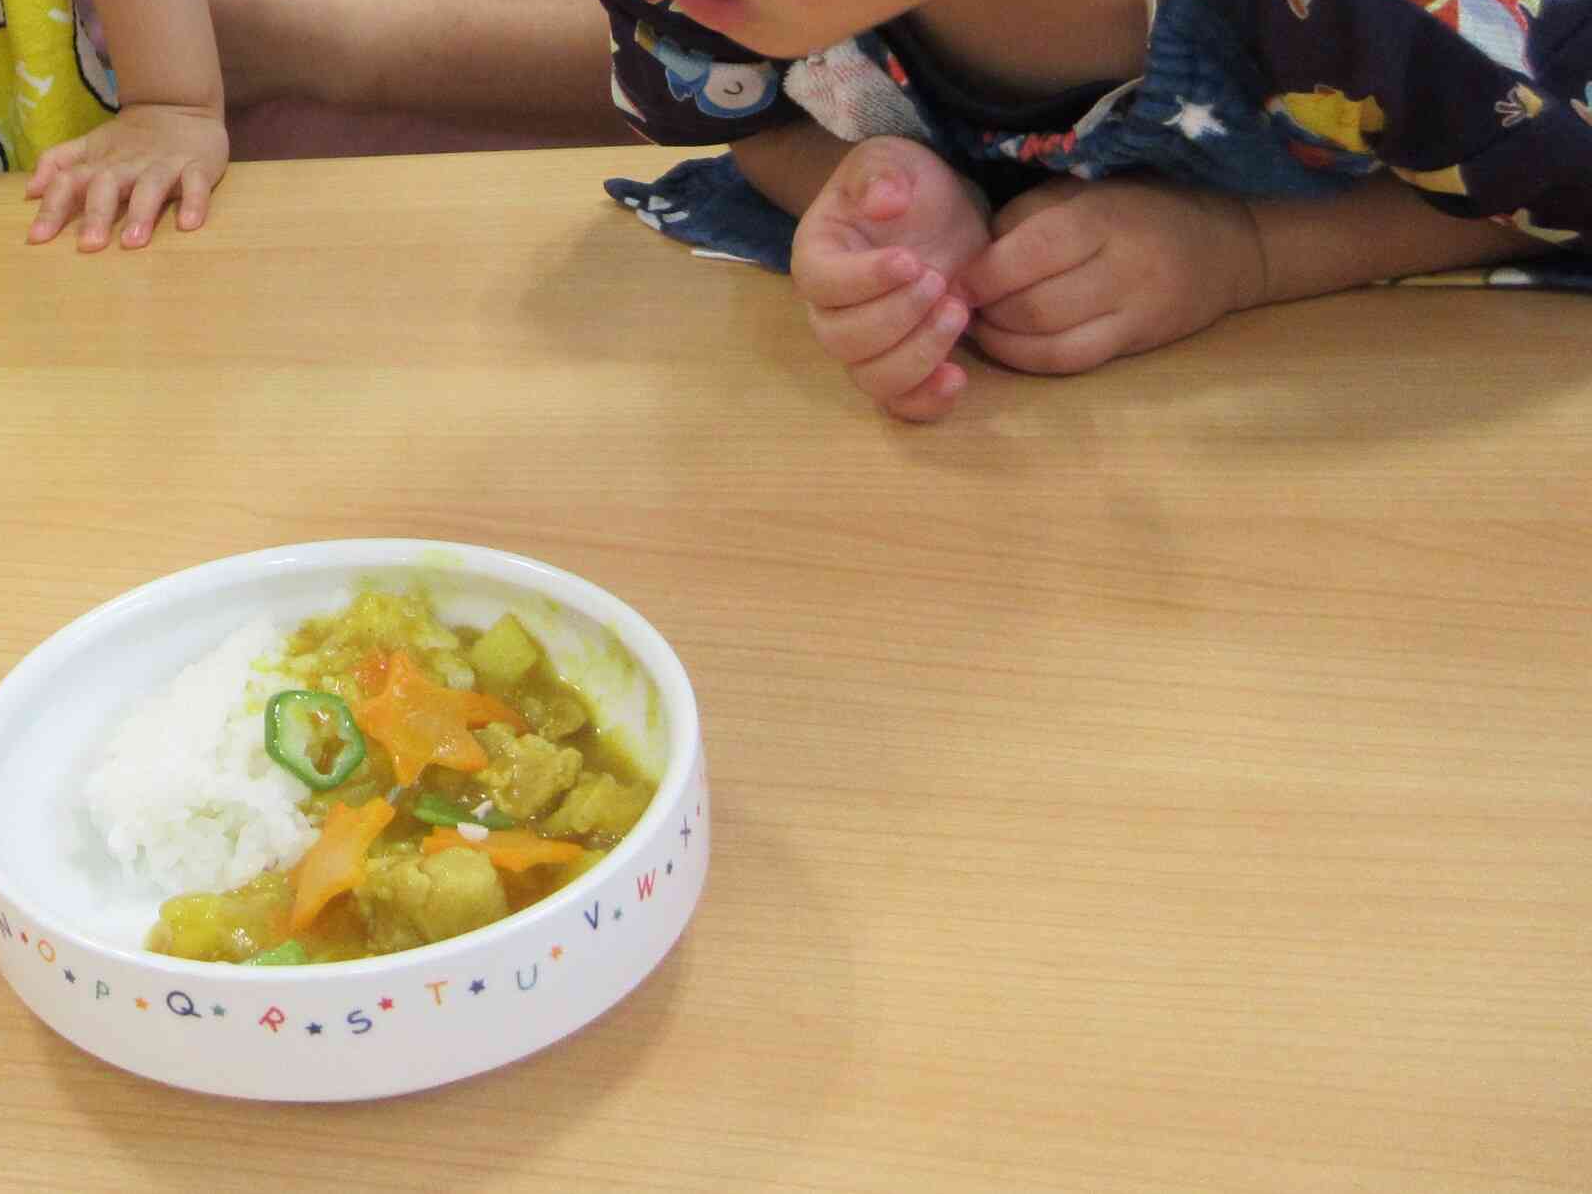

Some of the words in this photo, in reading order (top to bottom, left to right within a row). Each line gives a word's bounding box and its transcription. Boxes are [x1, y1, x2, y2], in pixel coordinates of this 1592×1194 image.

[36, 938, 56, 963] O
[166, 990, 203, 1018] Q
[258, 1005, 286, 1033] R
[346, 1008, 373, 1035] S
[424, 979, 448, 1006] T
[515, 962, 538, 991] U
[583, 900, 601, 931] V
[636, 867, 657, 902] W
